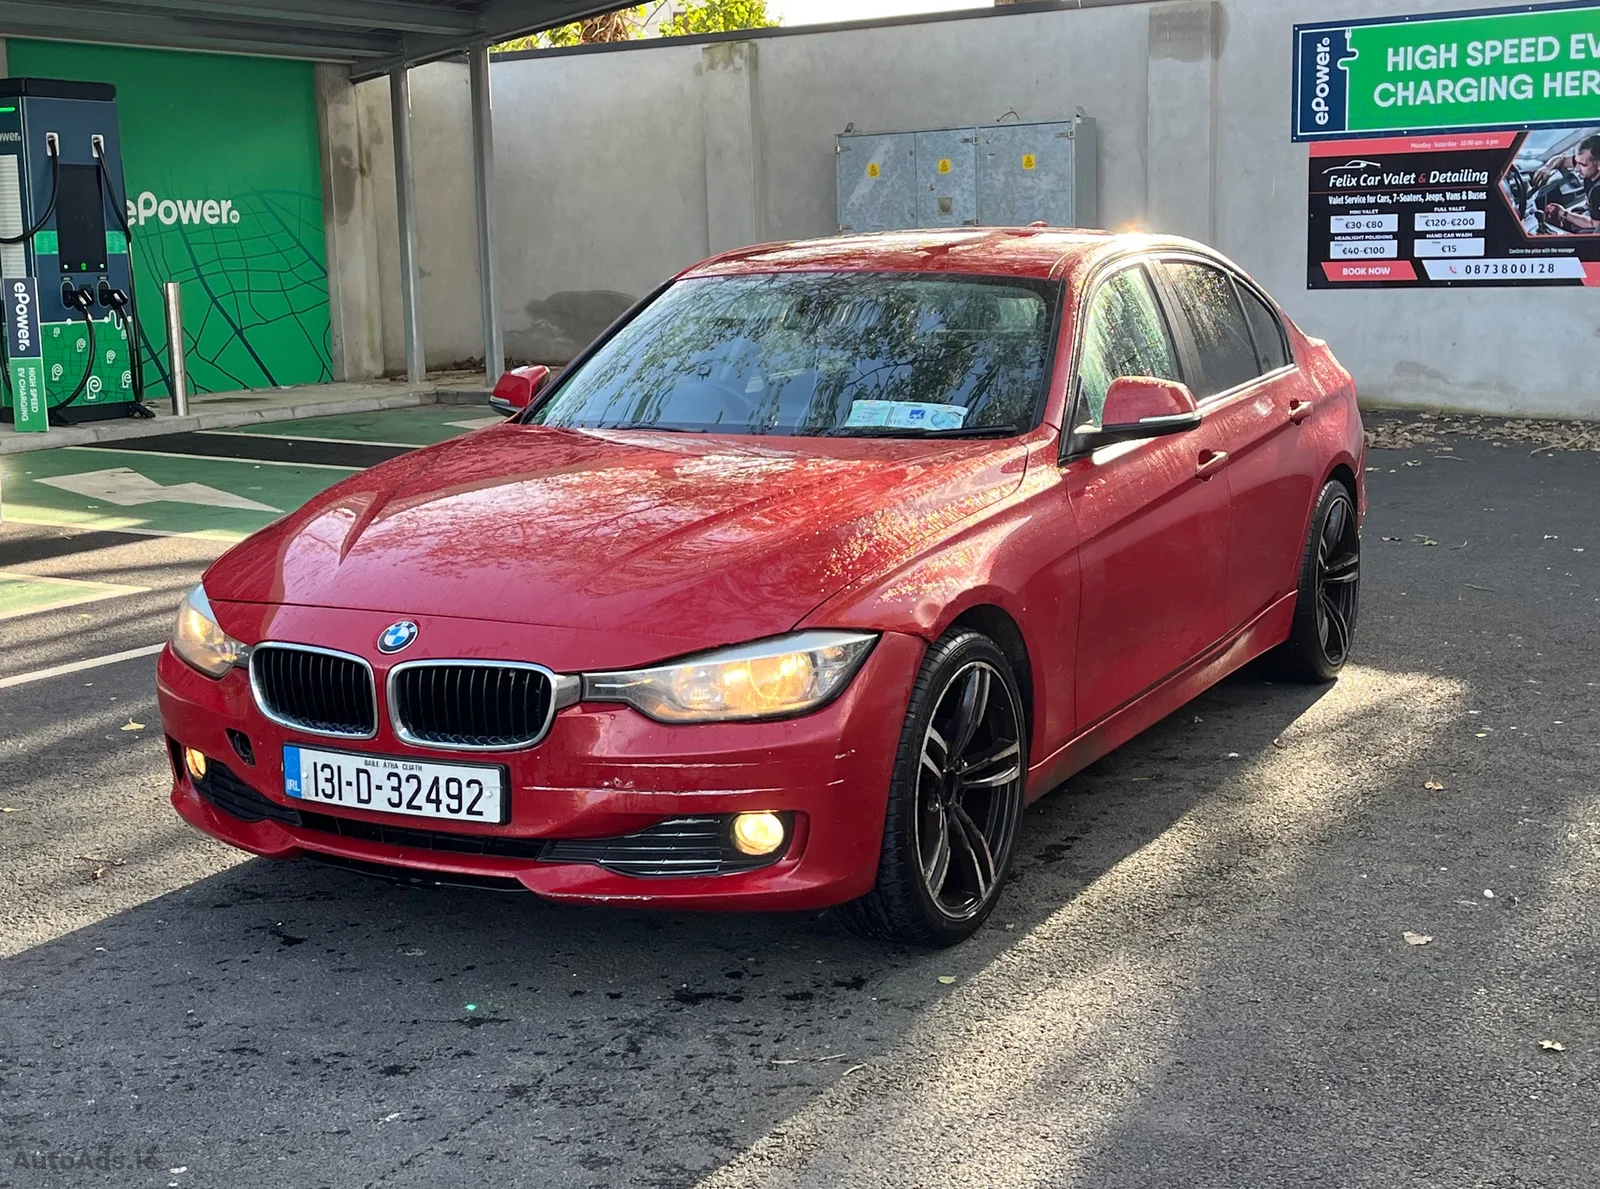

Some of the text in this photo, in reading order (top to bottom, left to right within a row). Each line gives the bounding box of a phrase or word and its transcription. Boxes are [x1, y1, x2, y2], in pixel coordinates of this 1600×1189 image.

[1387, 43, 1457, 72] HIGH
[1467, 36, 1560, 67] SPEED
[1312, 38, 1331, 125] ePower
[1373, 74, 1533, 107] CHARGING
[1329, 169, 1489, 188] Felix Car Valet & Detailing
[126, 191, 232, 225] ePower
[1328, 189, 1487, 205] Valet Service for Cars, 7-Seaters, Jeeps, Vans & Buses
[1441, 244, 1457, 253] €15
[1342, 266, 1391, 276] BOOK NOW
[13, 281, 30, 352] ePower
[17, 367, 29, 421] EV CHARGING
[28, 367, 38, 413] HIGH SPEED
[286, 778, 301, 792] IRL
[313, 761, 484, 817] 131-D-32492
